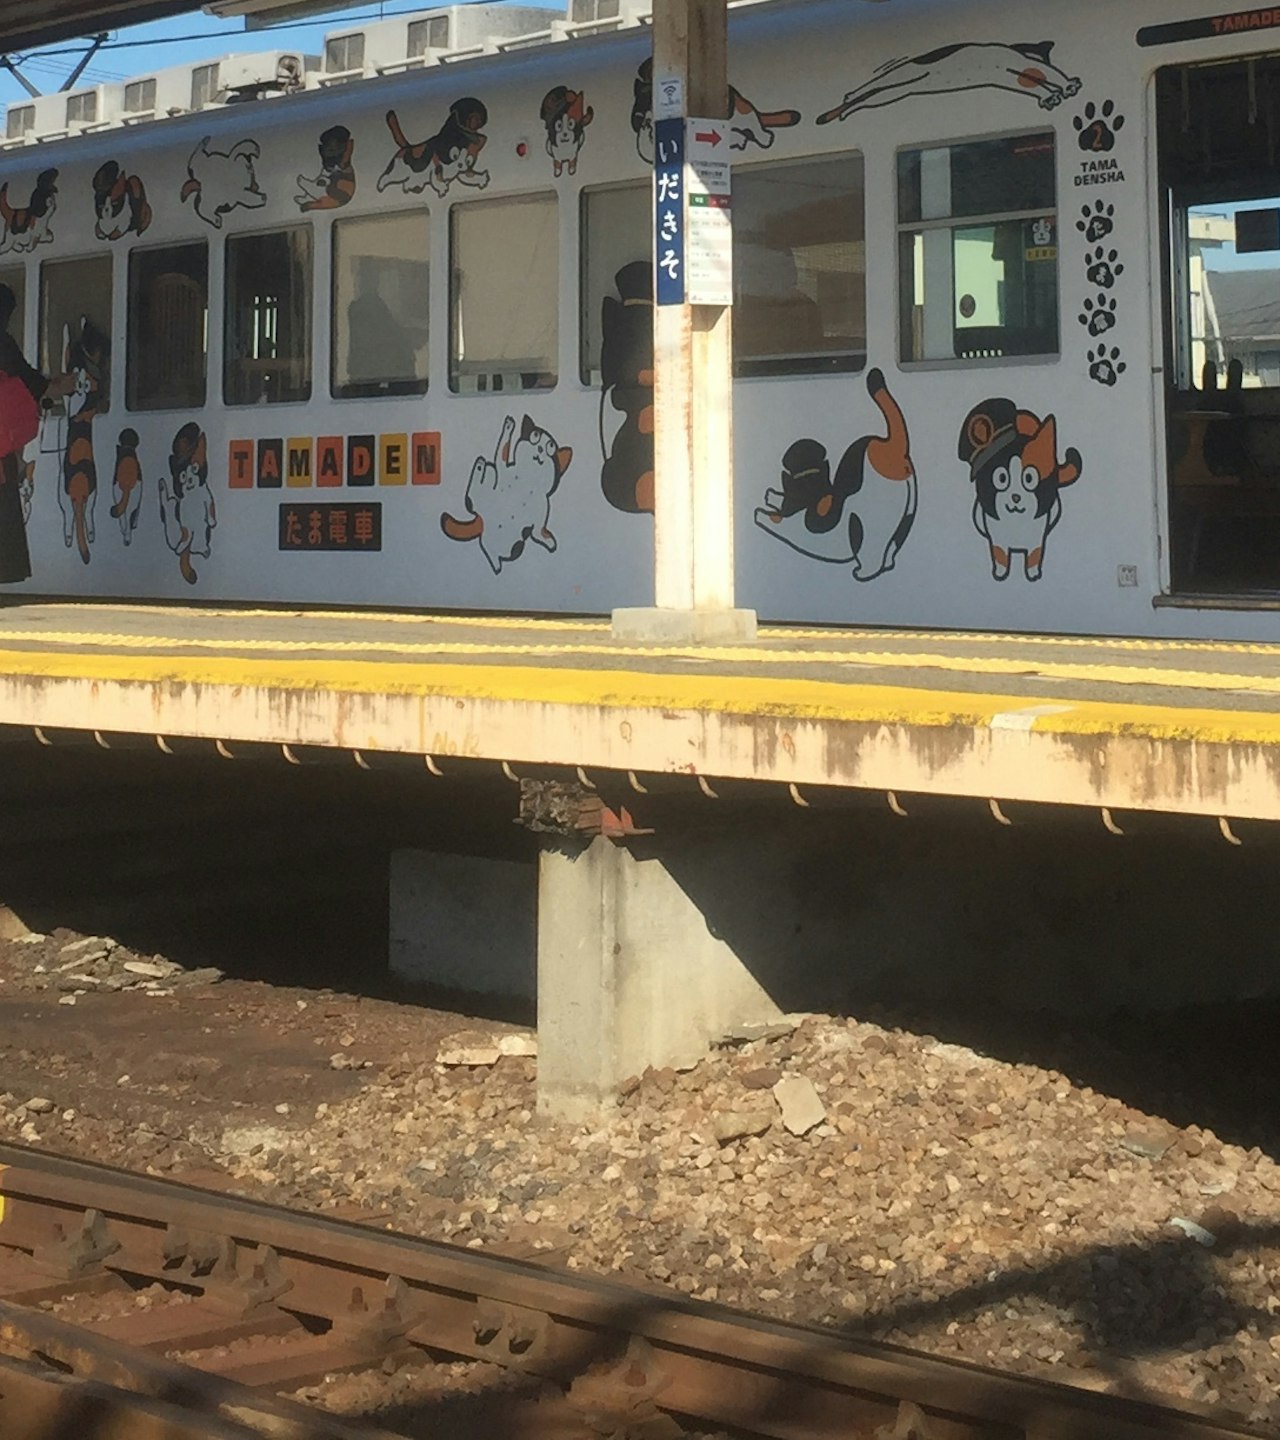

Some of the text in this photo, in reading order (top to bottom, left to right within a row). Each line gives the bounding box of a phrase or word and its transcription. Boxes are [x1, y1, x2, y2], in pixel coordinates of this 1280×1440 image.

[1093, 125, 1102, 149] 2
[1074, 170, 1125, 186] DENSHA
[1080, 159, 1118, 173] TAMA
[659, 139, 679, 280] いだきそ
[233, 444, 437, 479] TAMADEN
[286, 510, 374, 545] たま電車
